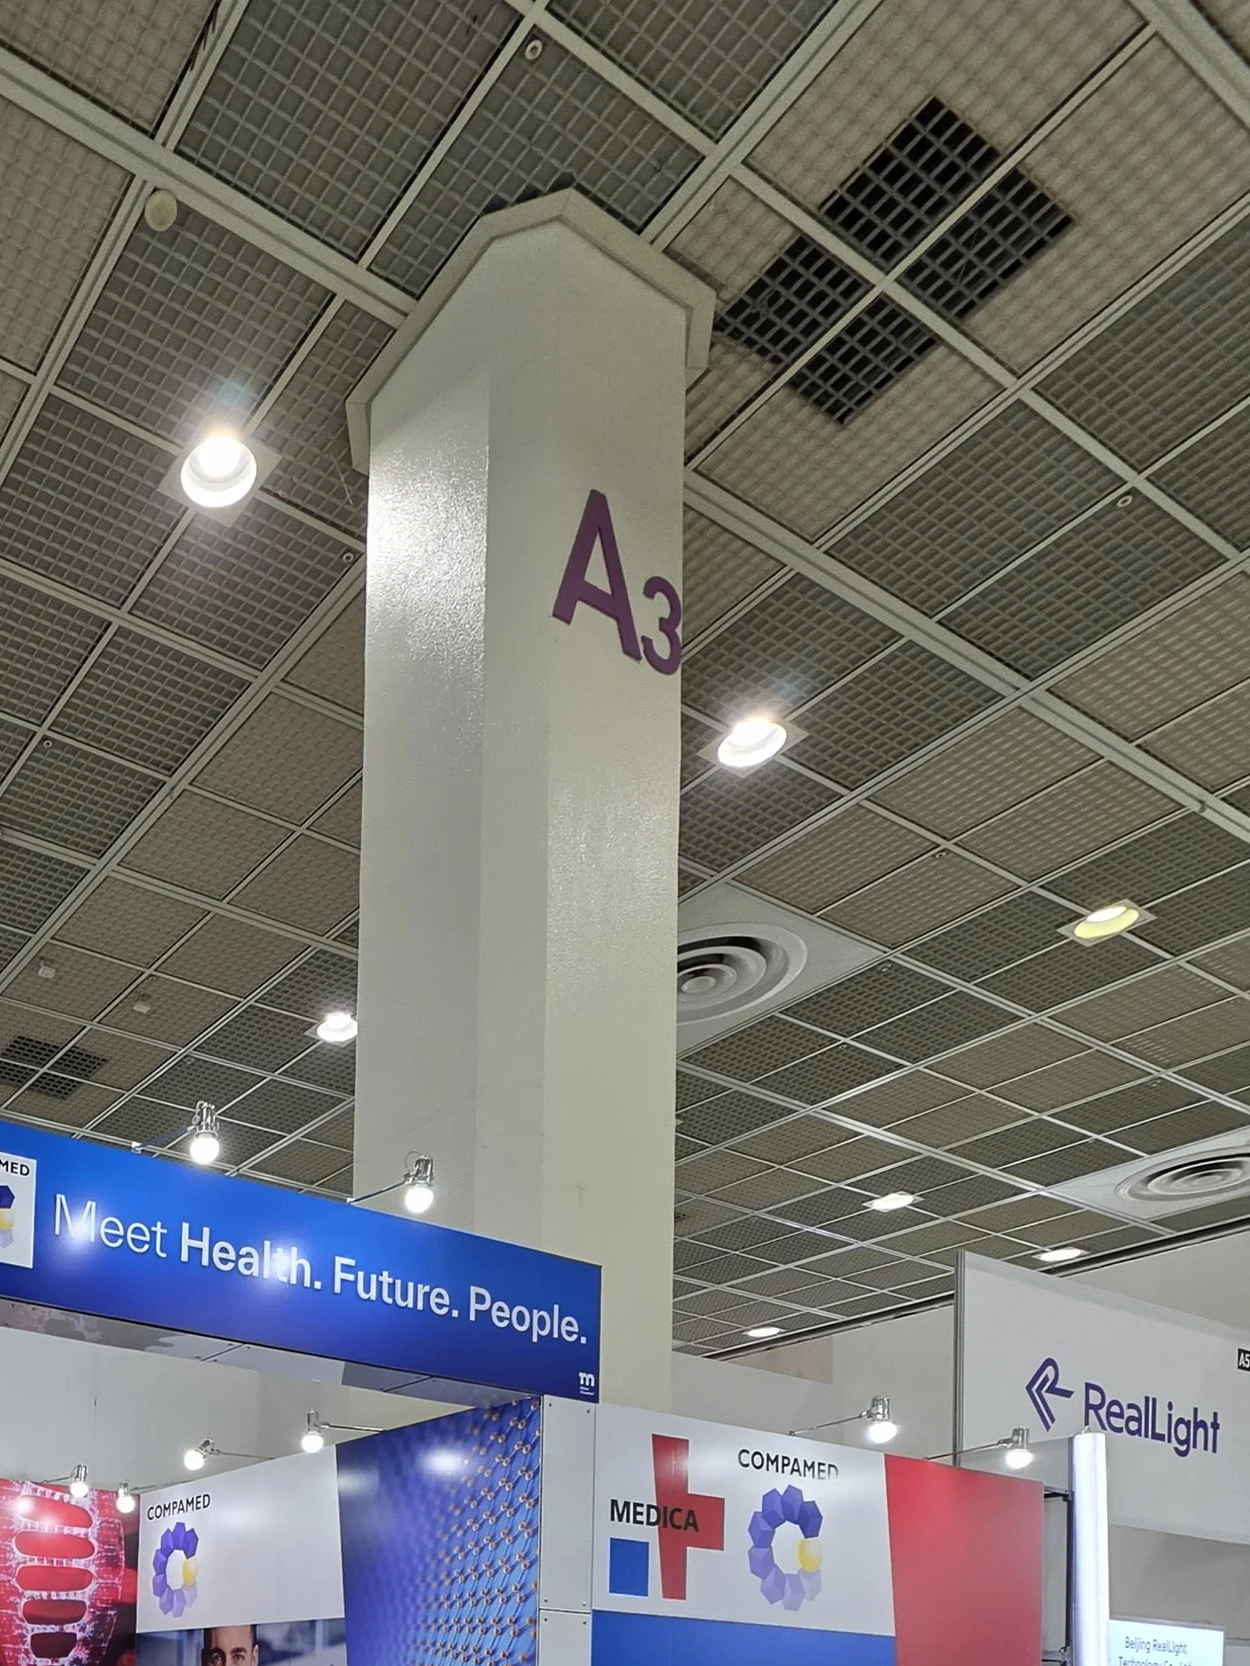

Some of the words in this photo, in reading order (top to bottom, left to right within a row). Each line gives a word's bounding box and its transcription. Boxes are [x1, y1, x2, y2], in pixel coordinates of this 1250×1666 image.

[552, 489, 682, 675] A3
[53, 1194, 168, 1258] Meet
[181, 1222, 321, 1290] Health.
[333, 1257, 458, 1318] Future.
[469, 1286, 587, 1344] People.
[1084, 1381, 1220, 1457] RealLight
[738, 1448, 839, 1481] COMPAMED
[147, 1493, 211, 1520] COMPAMED
[610, 1499, 699, 1532] MEDICA
[1125, 1636, 1151, 1653] Beijing
